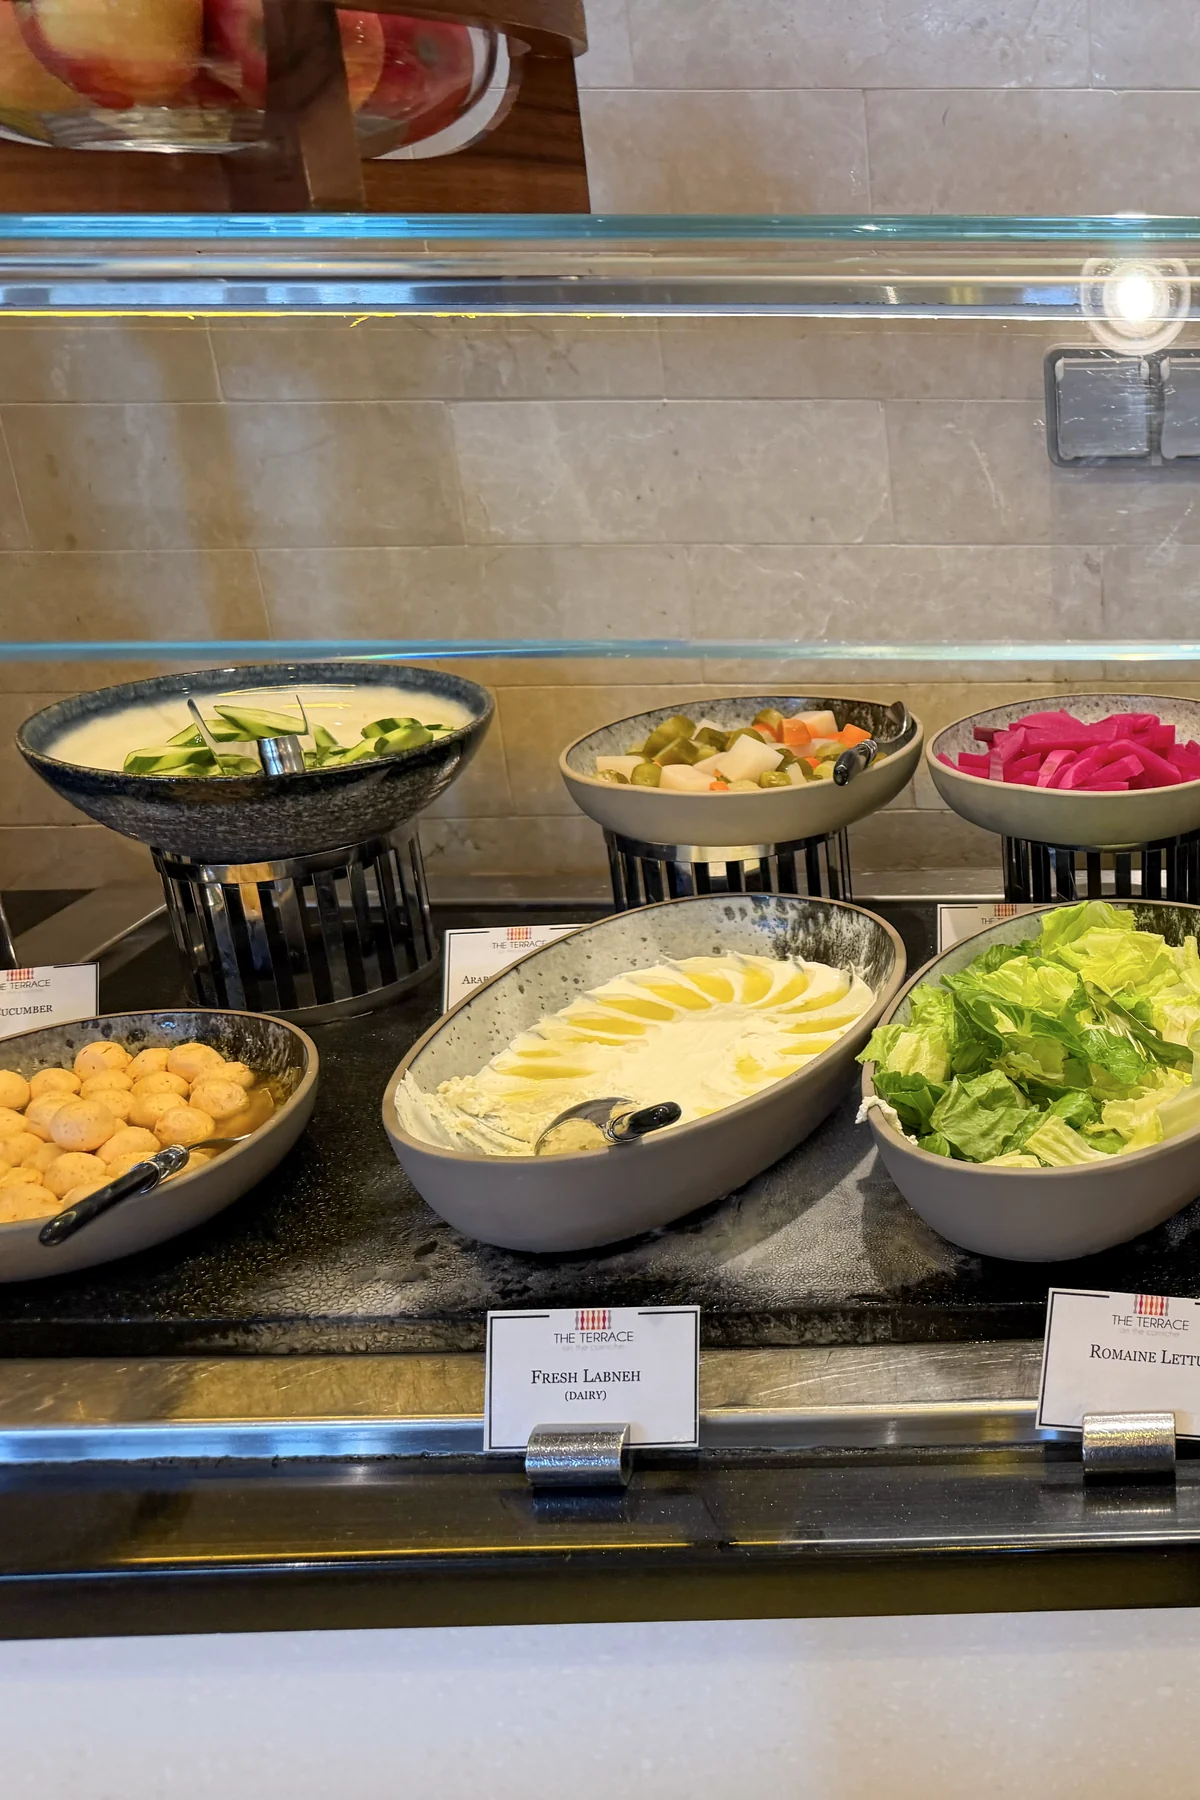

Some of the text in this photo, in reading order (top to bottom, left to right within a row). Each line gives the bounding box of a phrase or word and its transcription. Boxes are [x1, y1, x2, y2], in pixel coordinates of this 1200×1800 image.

[10, 979, 51, 990] TERRACE
[0, 1004, 53, 1016] UCUMBER
[1112, 1314, 1190, 1331] THE TERRACE
[553, 1331, 634, 1344] THE TERRACE
[1089, 1344, 1157, 1363] ROMAINE
[531, 1369, 641, 1384] FRESH LABNEH
[564, 1390, 607, 1402] (DAIRY)
